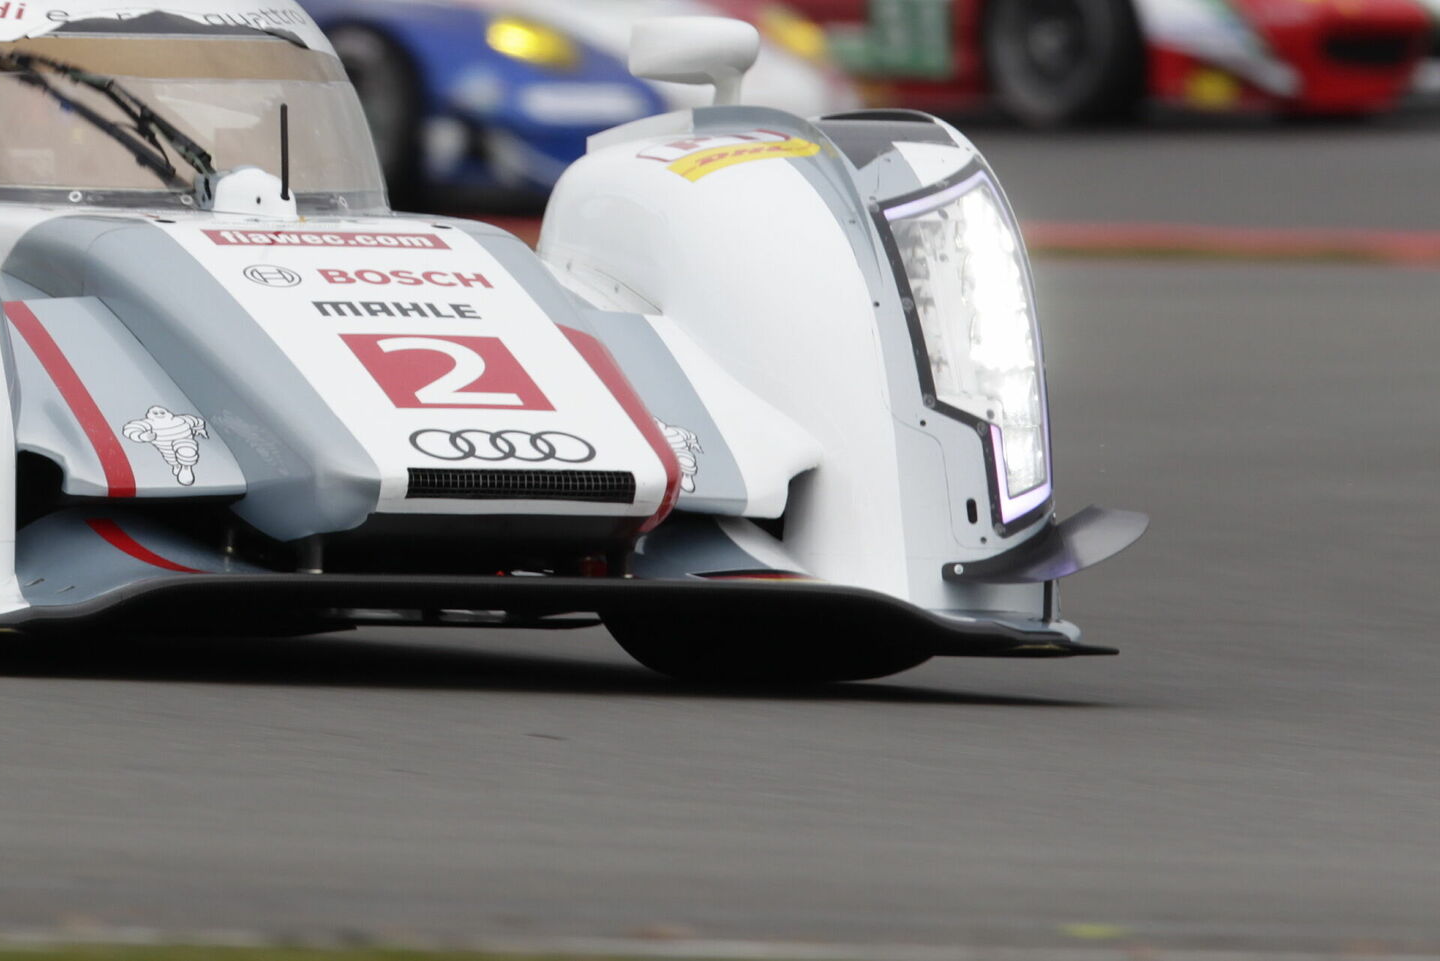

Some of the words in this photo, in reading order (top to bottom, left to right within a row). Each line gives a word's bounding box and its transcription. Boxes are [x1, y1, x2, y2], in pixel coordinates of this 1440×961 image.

[220, 230, 434, 248] fiawec.com
[317, 268, 495, 289] BOSCH
[311, 300, 483, 320] MAHLE
[376, 336, 525, 407] 2
